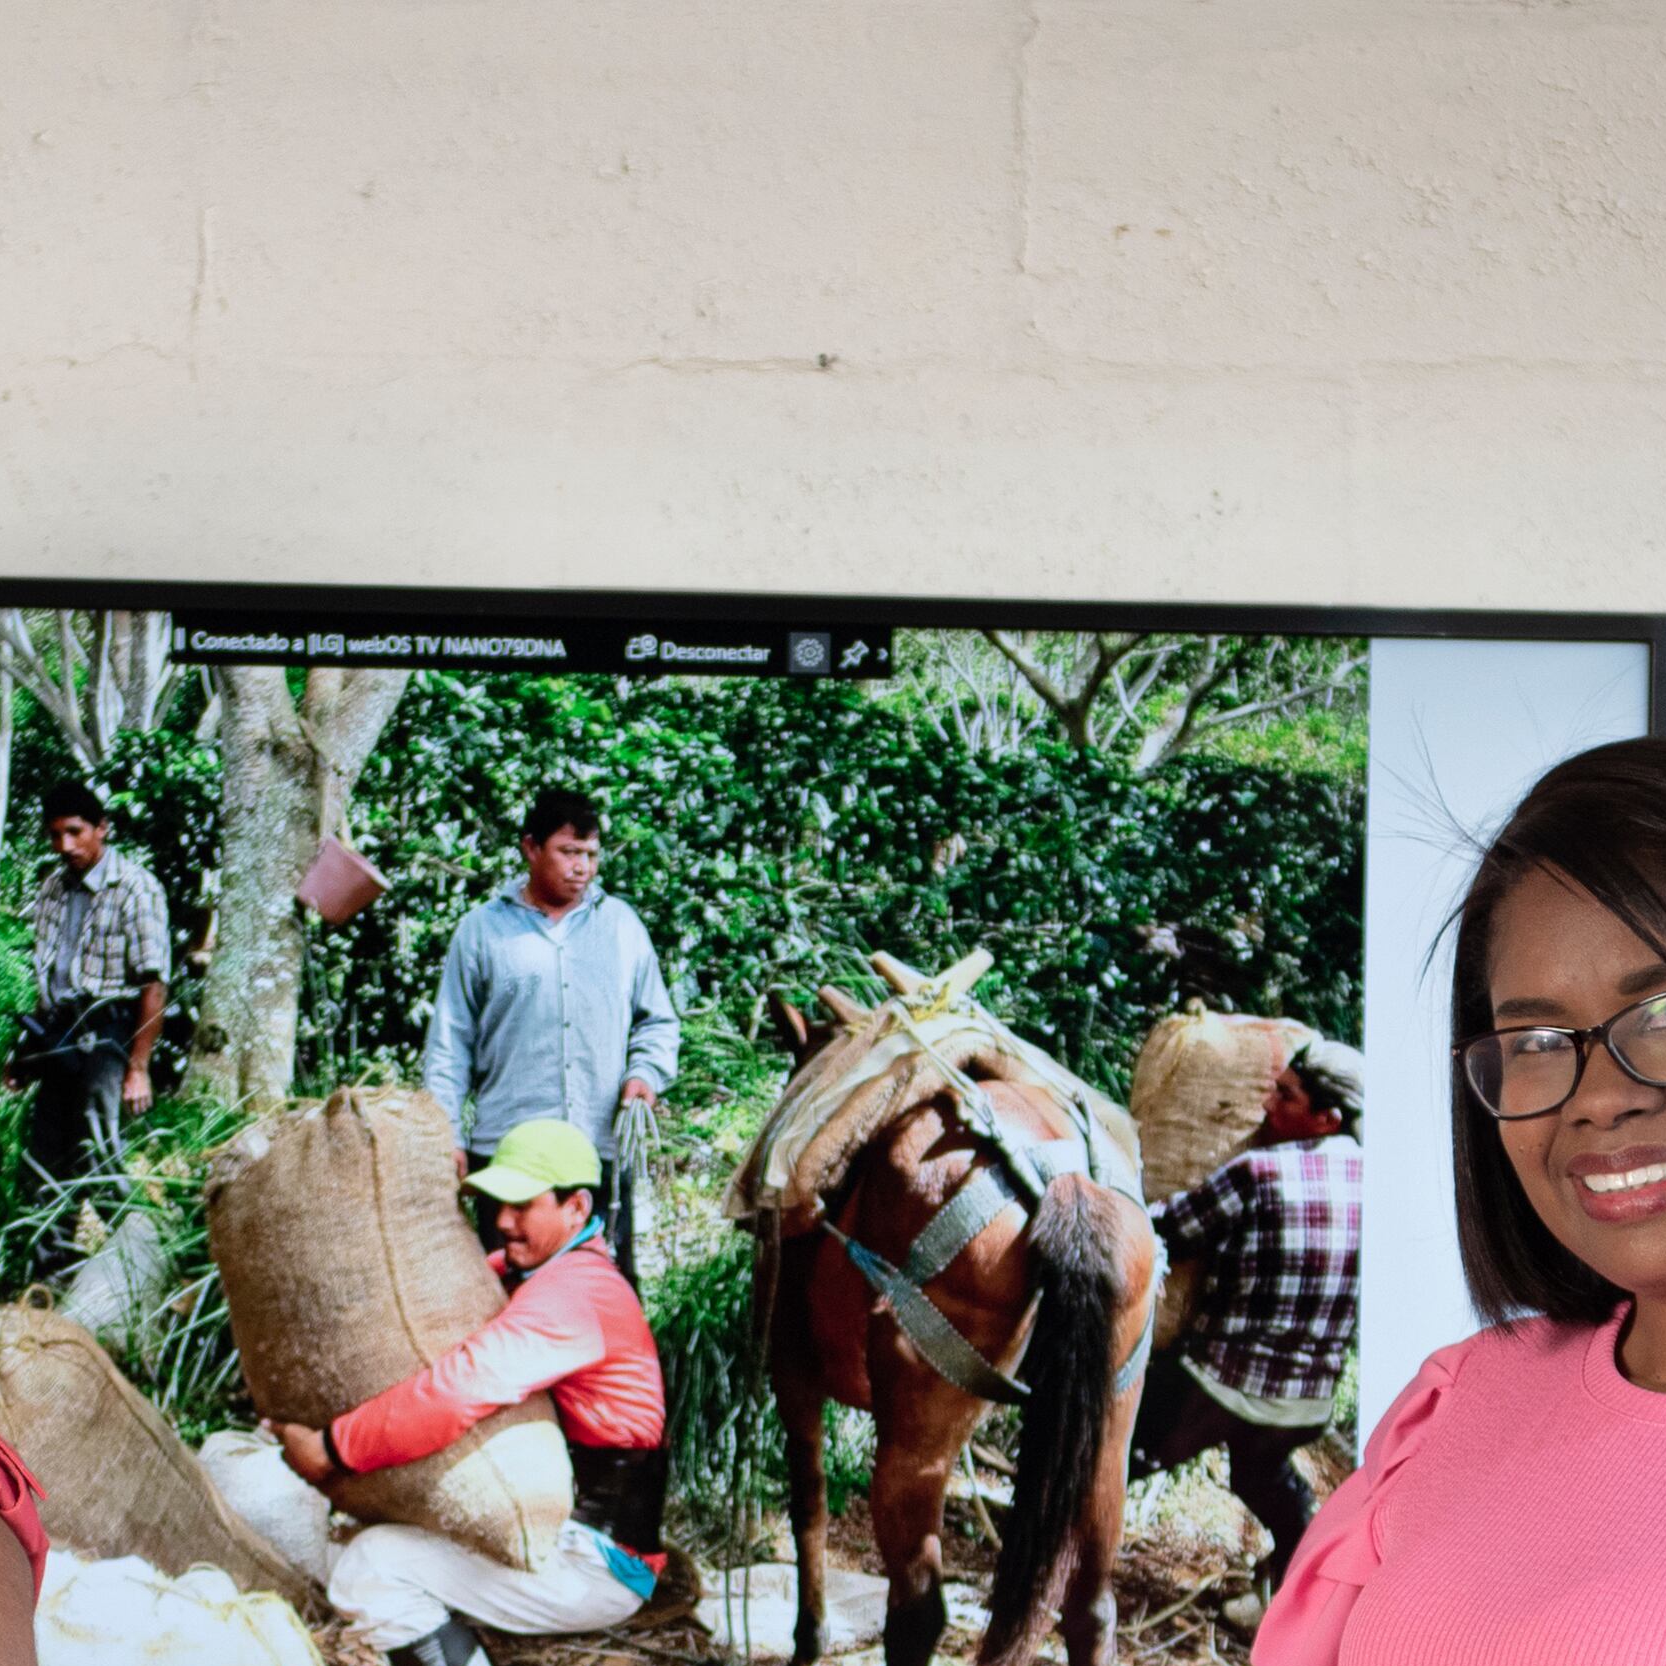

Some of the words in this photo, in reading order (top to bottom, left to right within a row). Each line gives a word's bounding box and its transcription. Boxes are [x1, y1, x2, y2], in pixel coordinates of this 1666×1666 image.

[190, 630, 290, 652] Conectado
[291, 637, 305, 652] a
[307, 633, 345, 657] [LG]
[346, 635, 412, 655] webOS
[415, 636, 441, 654] TV
[442, 636, 568, 658] NANO79DNA
[660, 641, 772, 662] Desconectar
